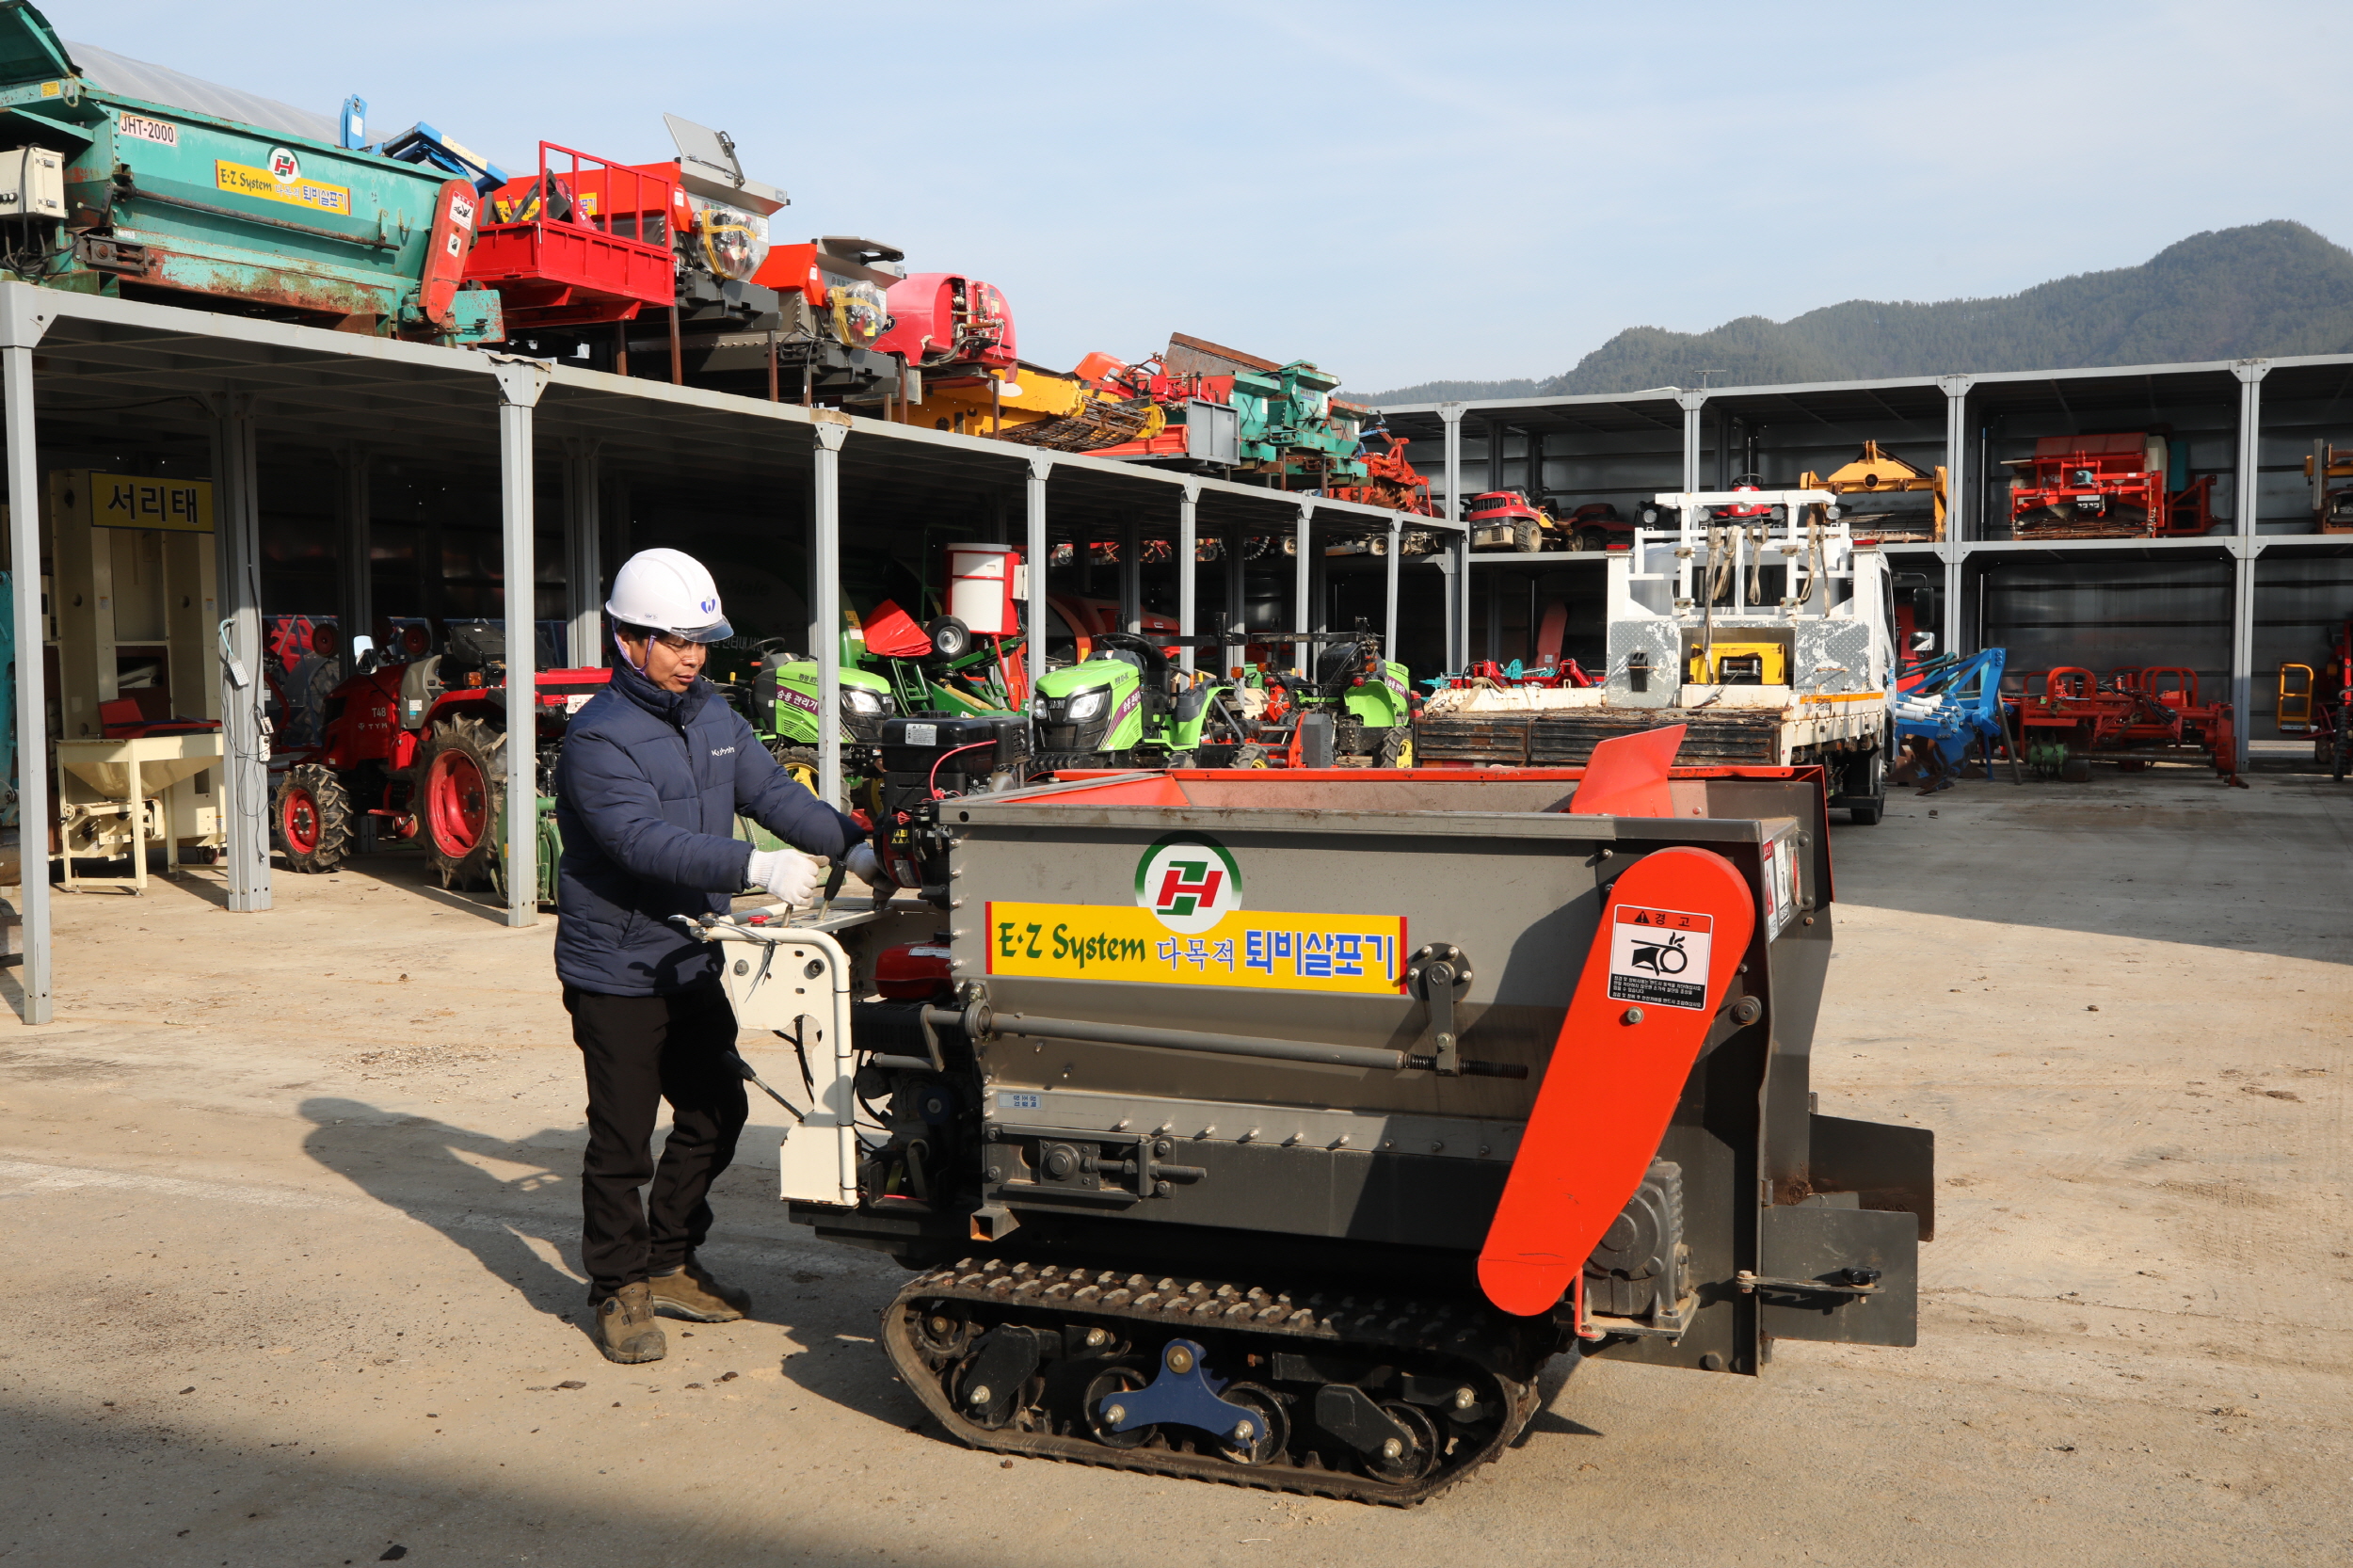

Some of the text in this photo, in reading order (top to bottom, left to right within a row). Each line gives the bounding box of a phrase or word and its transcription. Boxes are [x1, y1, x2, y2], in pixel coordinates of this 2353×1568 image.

[120, 116, 174, 143] JHT-2000
[240, 172, 272, 192] System
[303, 185, 347, 210] 퇴비살포기
[107, 483, 198, 524] 서리태
[372, 707, 386, 717] T48
[777, 689, 818, 710] 승용 관리기
[1052, 923, 1146, 969] System
[1155, 935, 1235, 973] 다목적
[1244, 929, 1394, 981] 퇴비살포기
